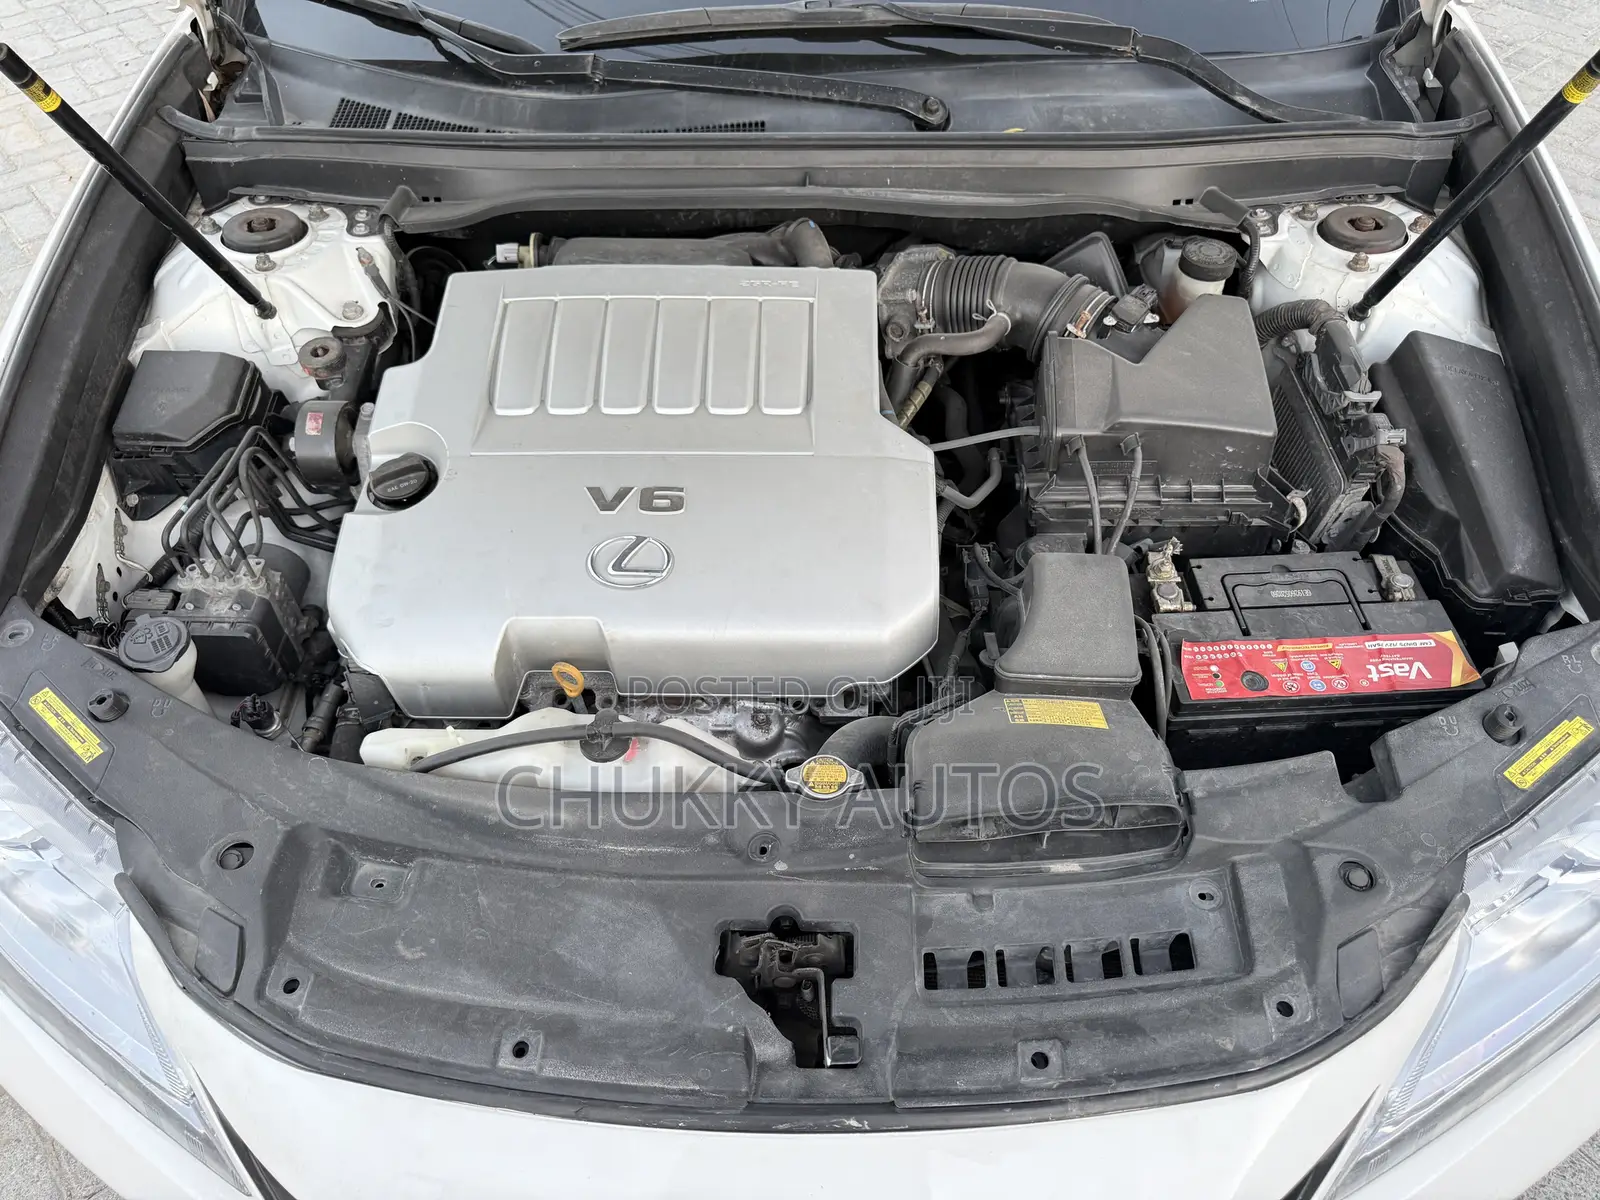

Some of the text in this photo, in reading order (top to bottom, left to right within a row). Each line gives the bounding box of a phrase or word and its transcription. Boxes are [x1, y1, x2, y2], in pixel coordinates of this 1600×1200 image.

[387, 485, 399, 493] SAE
[584, 486, 686, 514] V6
[1365, 661, 1433, 682] Vast
